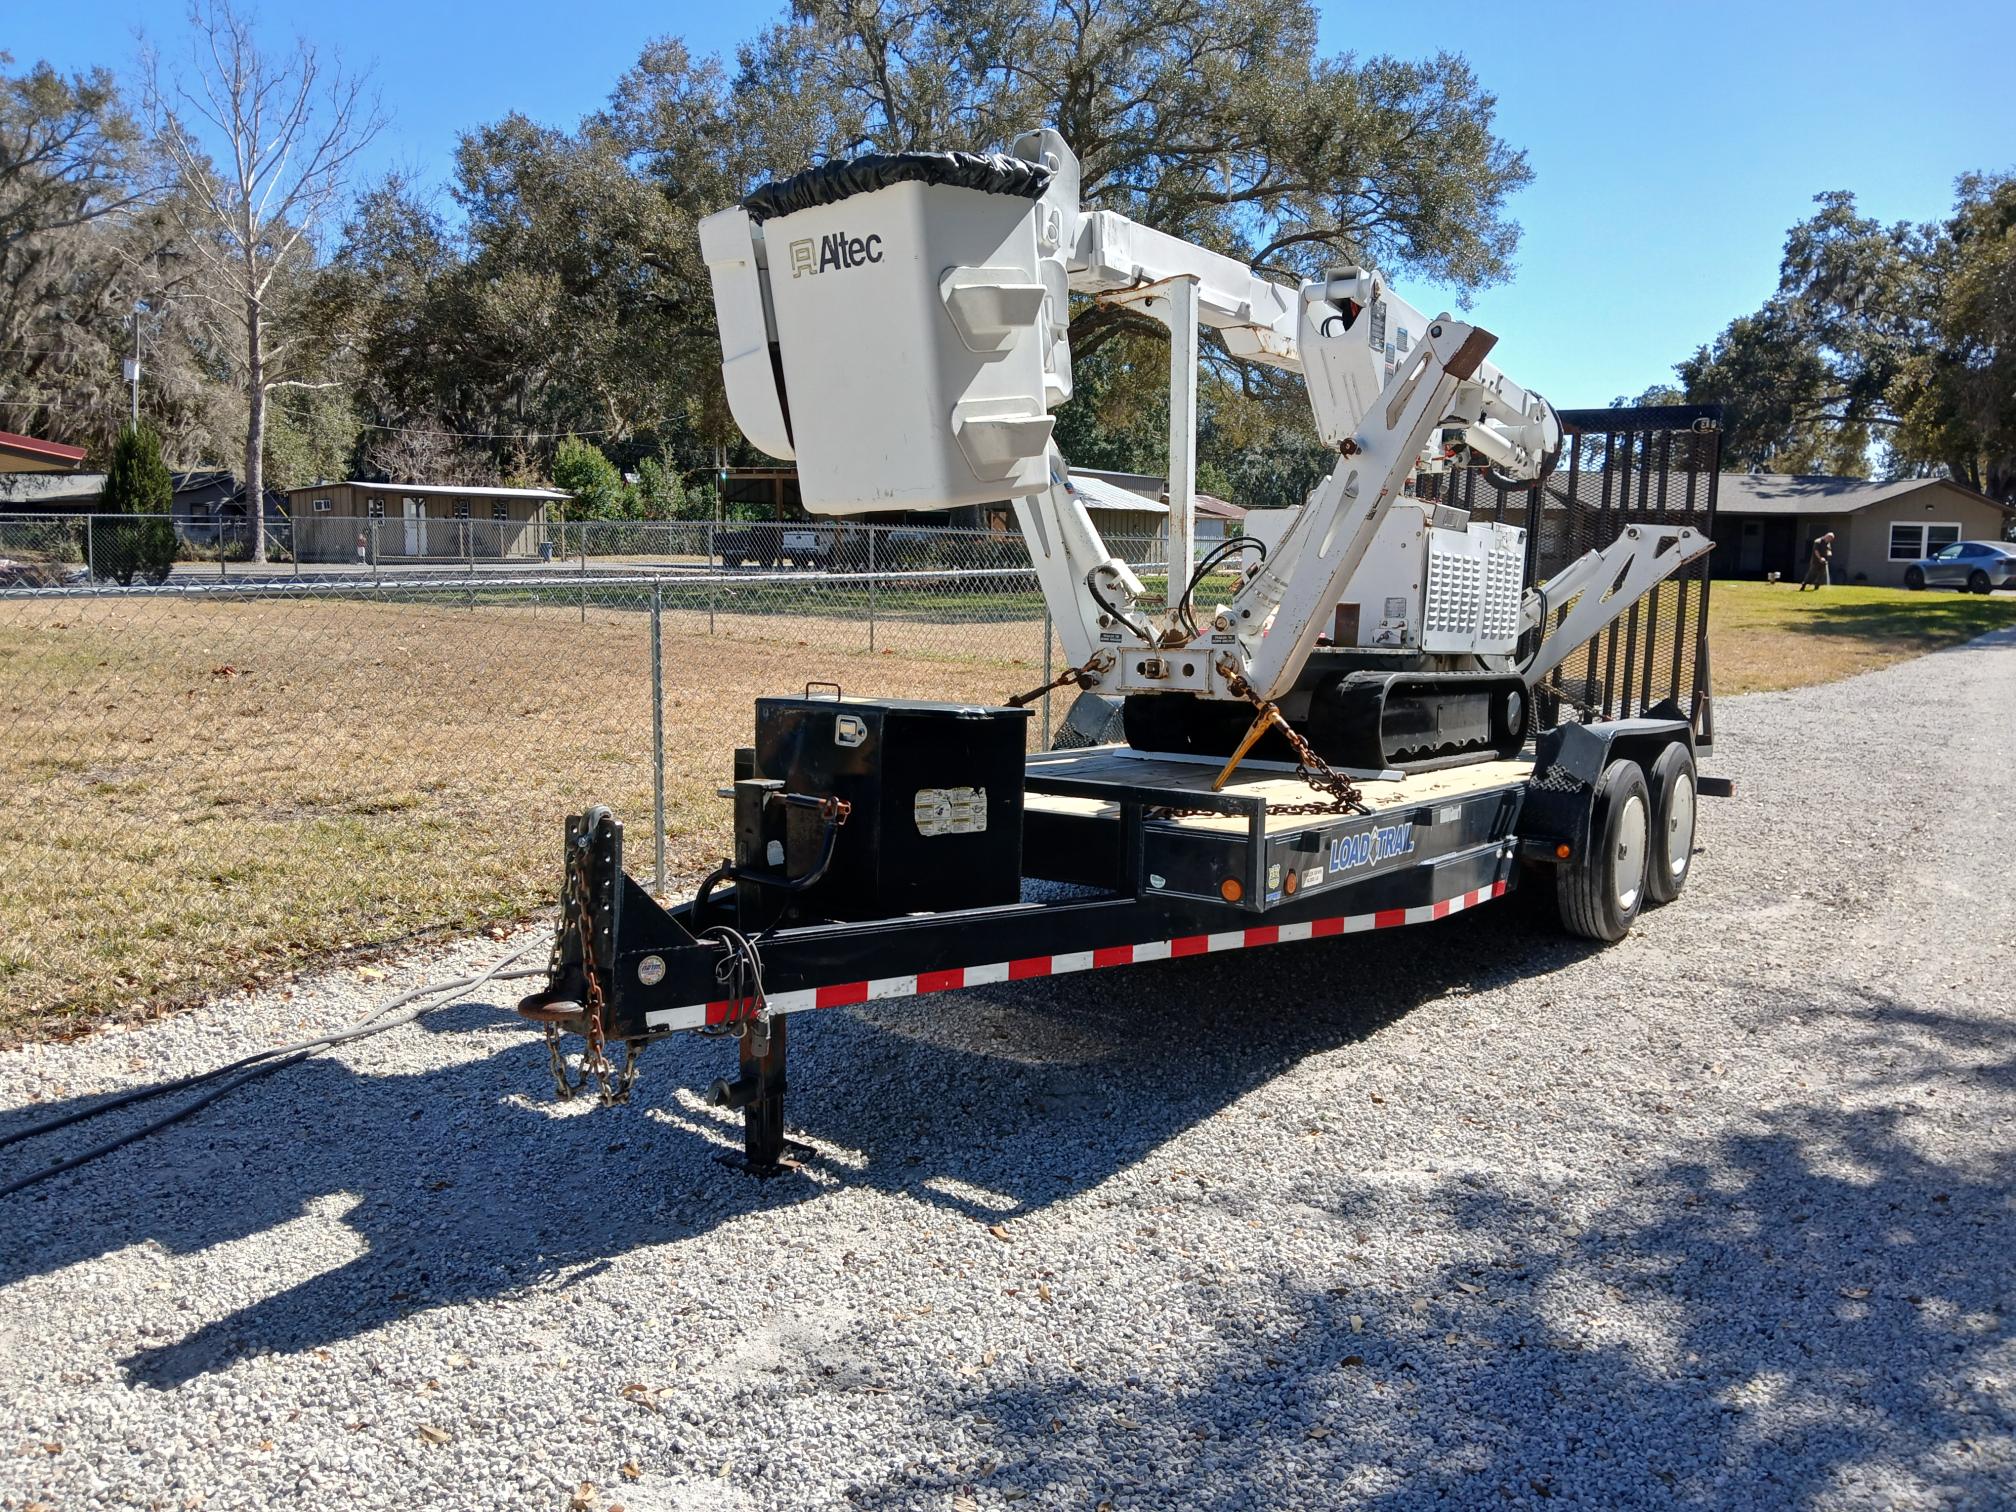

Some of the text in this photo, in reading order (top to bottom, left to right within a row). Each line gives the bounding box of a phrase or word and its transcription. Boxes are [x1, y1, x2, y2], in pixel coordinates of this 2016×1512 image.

[819, 231, 883, 273] Altec
[1329, 822, 1415, 873] LOAD TRAIL
